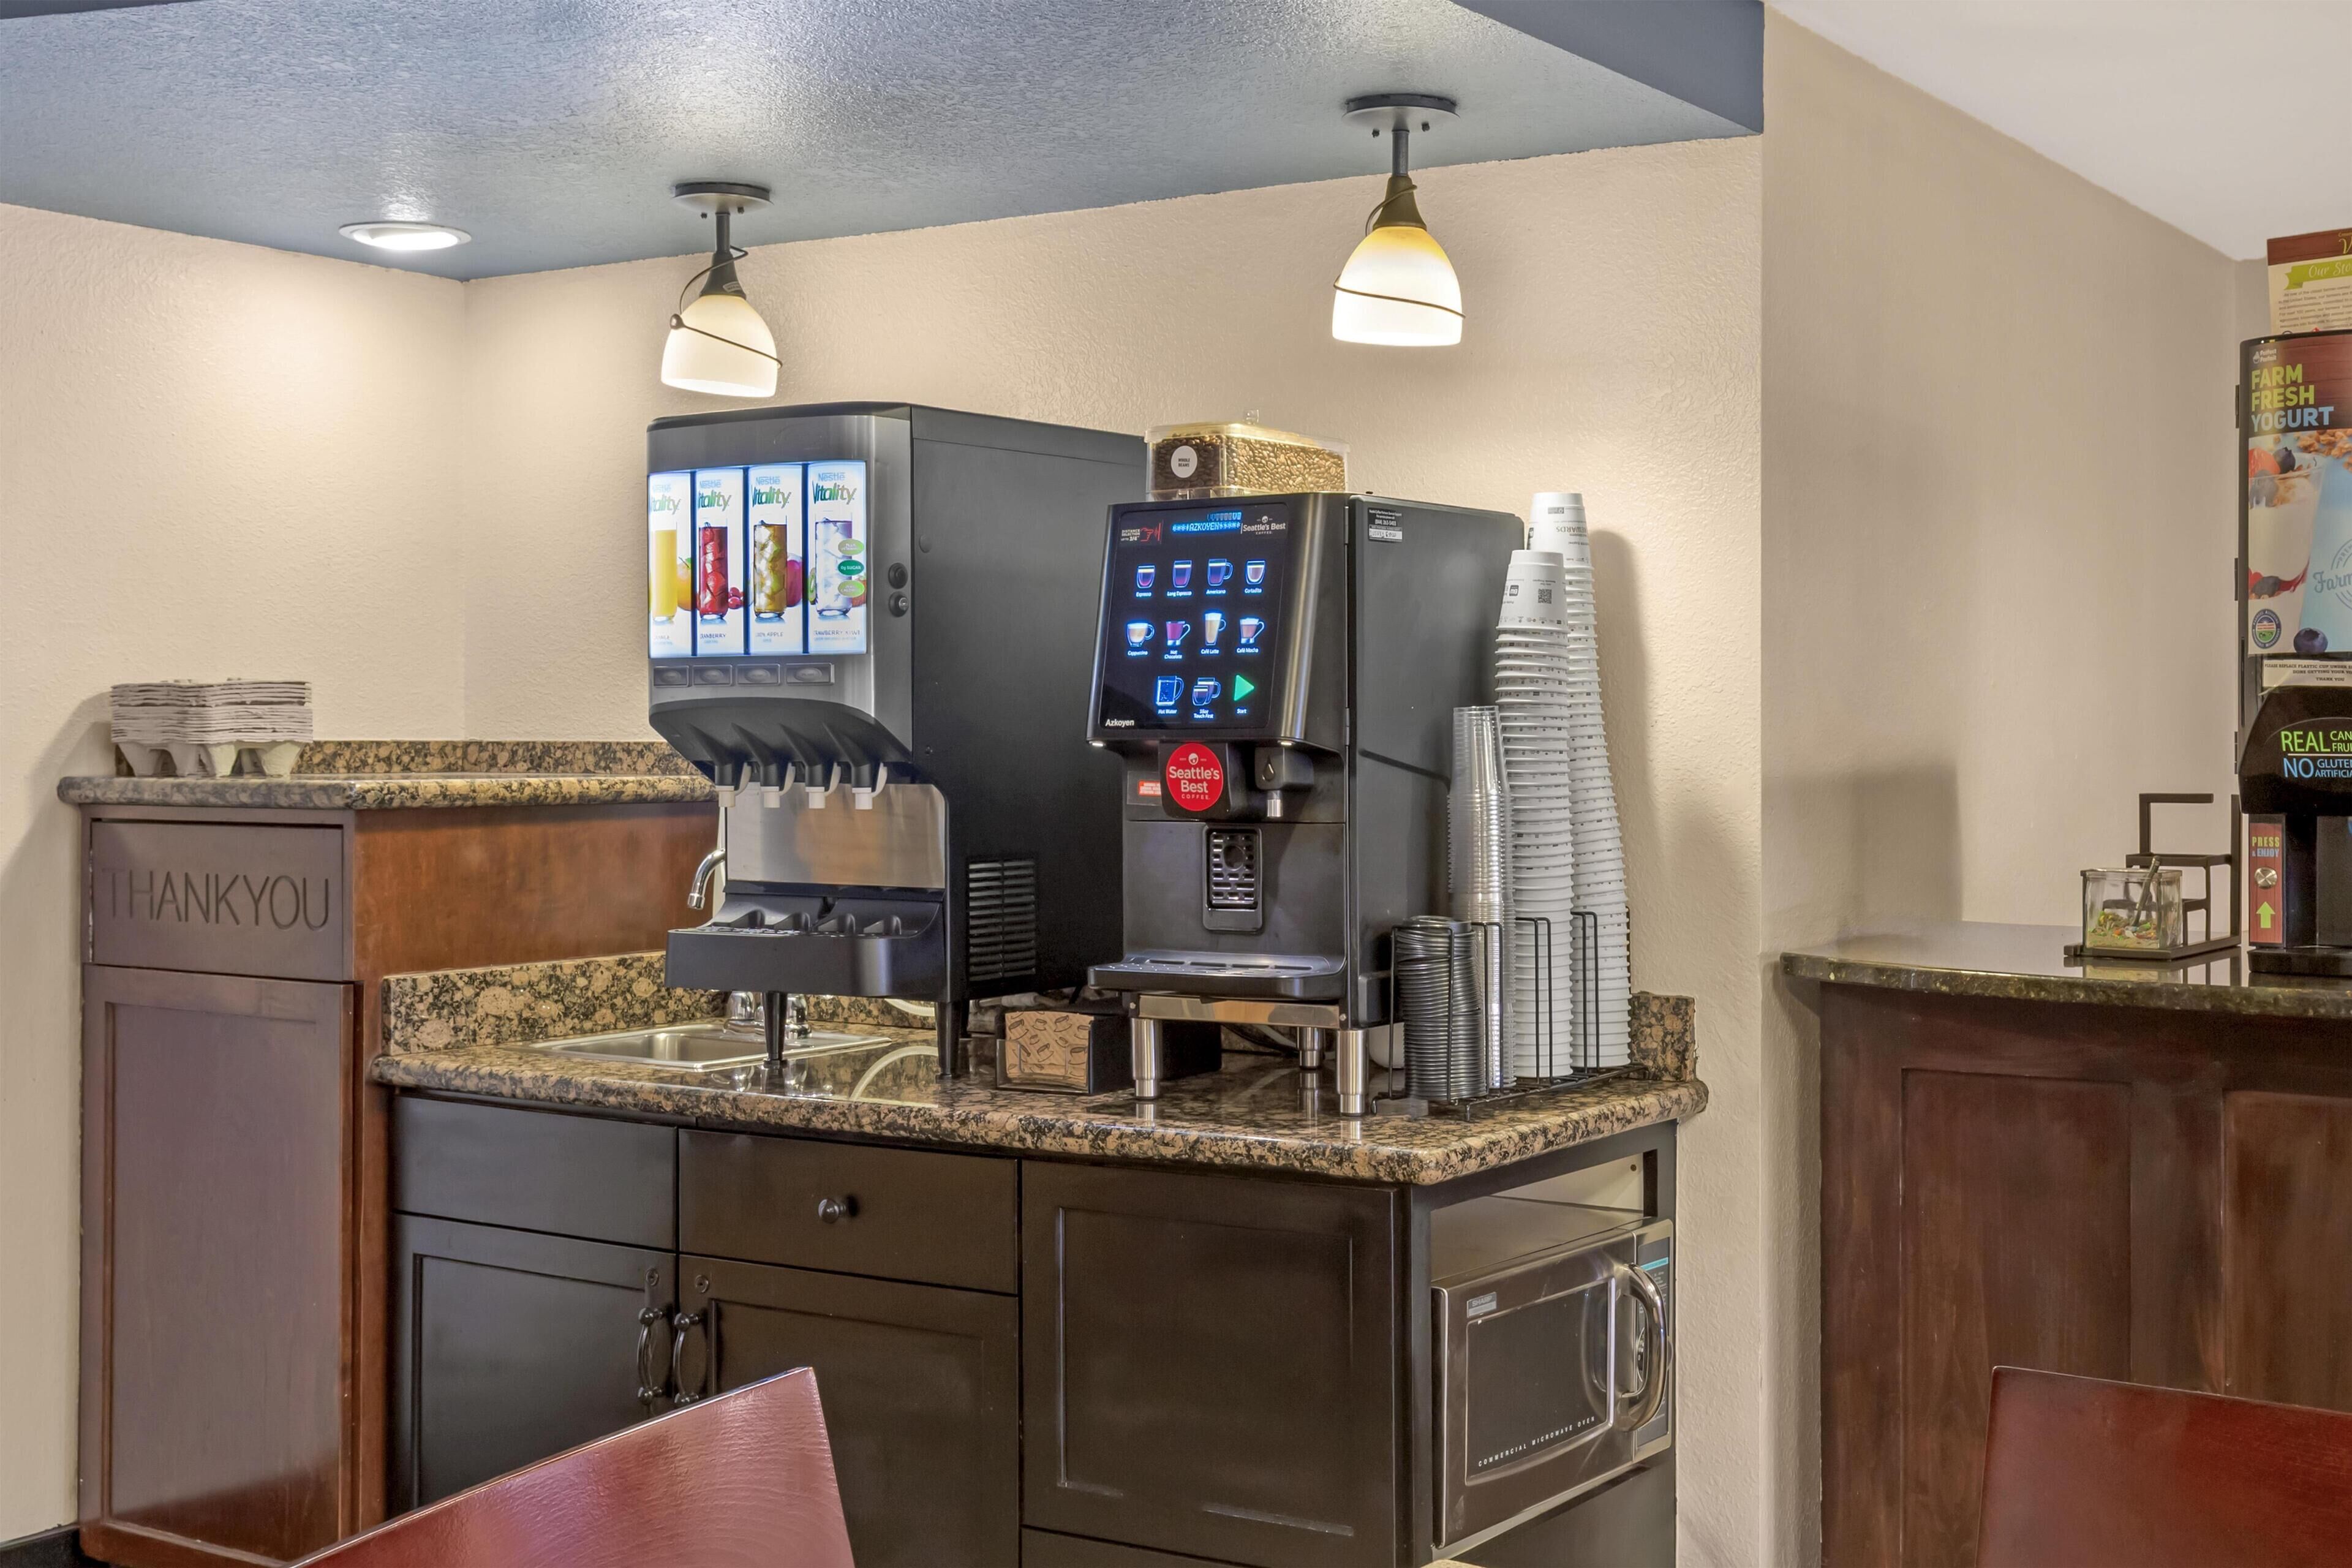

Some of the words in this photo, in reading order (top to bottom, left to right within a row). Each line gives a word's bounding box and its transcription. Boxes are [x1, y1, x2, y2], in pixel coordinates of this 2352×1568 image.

[2309, 265, 2329, 278] Our
[2252, 364, 2302, 390] FARM
[2252, 385, 2315, 412] FRESH
[2251, 406, 2334, 432] YOGURT
[751, 484, 791, 509] Vitality
[812, 480, 857, 505] Vitality
[1243, 524, 1270, 532] Seattle's
[1105, 718, 1134, 728] Azkoyen
[2280, 731, 2331, 752] REAL
[2330, 731, 2352, 741] CAN
[1169, 766, 1220, 780] Seattle's
[2283, 758, 2314, 778] NO
[1180, 780, 1208, 793] Best
[2252, 837, 2280, 847] PRESS
[2257, 848, 2280, 858] ENJOY
[1472, 1295, 1493, 1307] SHARP
[1478, 1443, 1526, 1467] COMMERCIAL
[1532, 1425, 1573, 1446] MICROWAVE
[1577, 1416, 1595, 1428] OVEN
